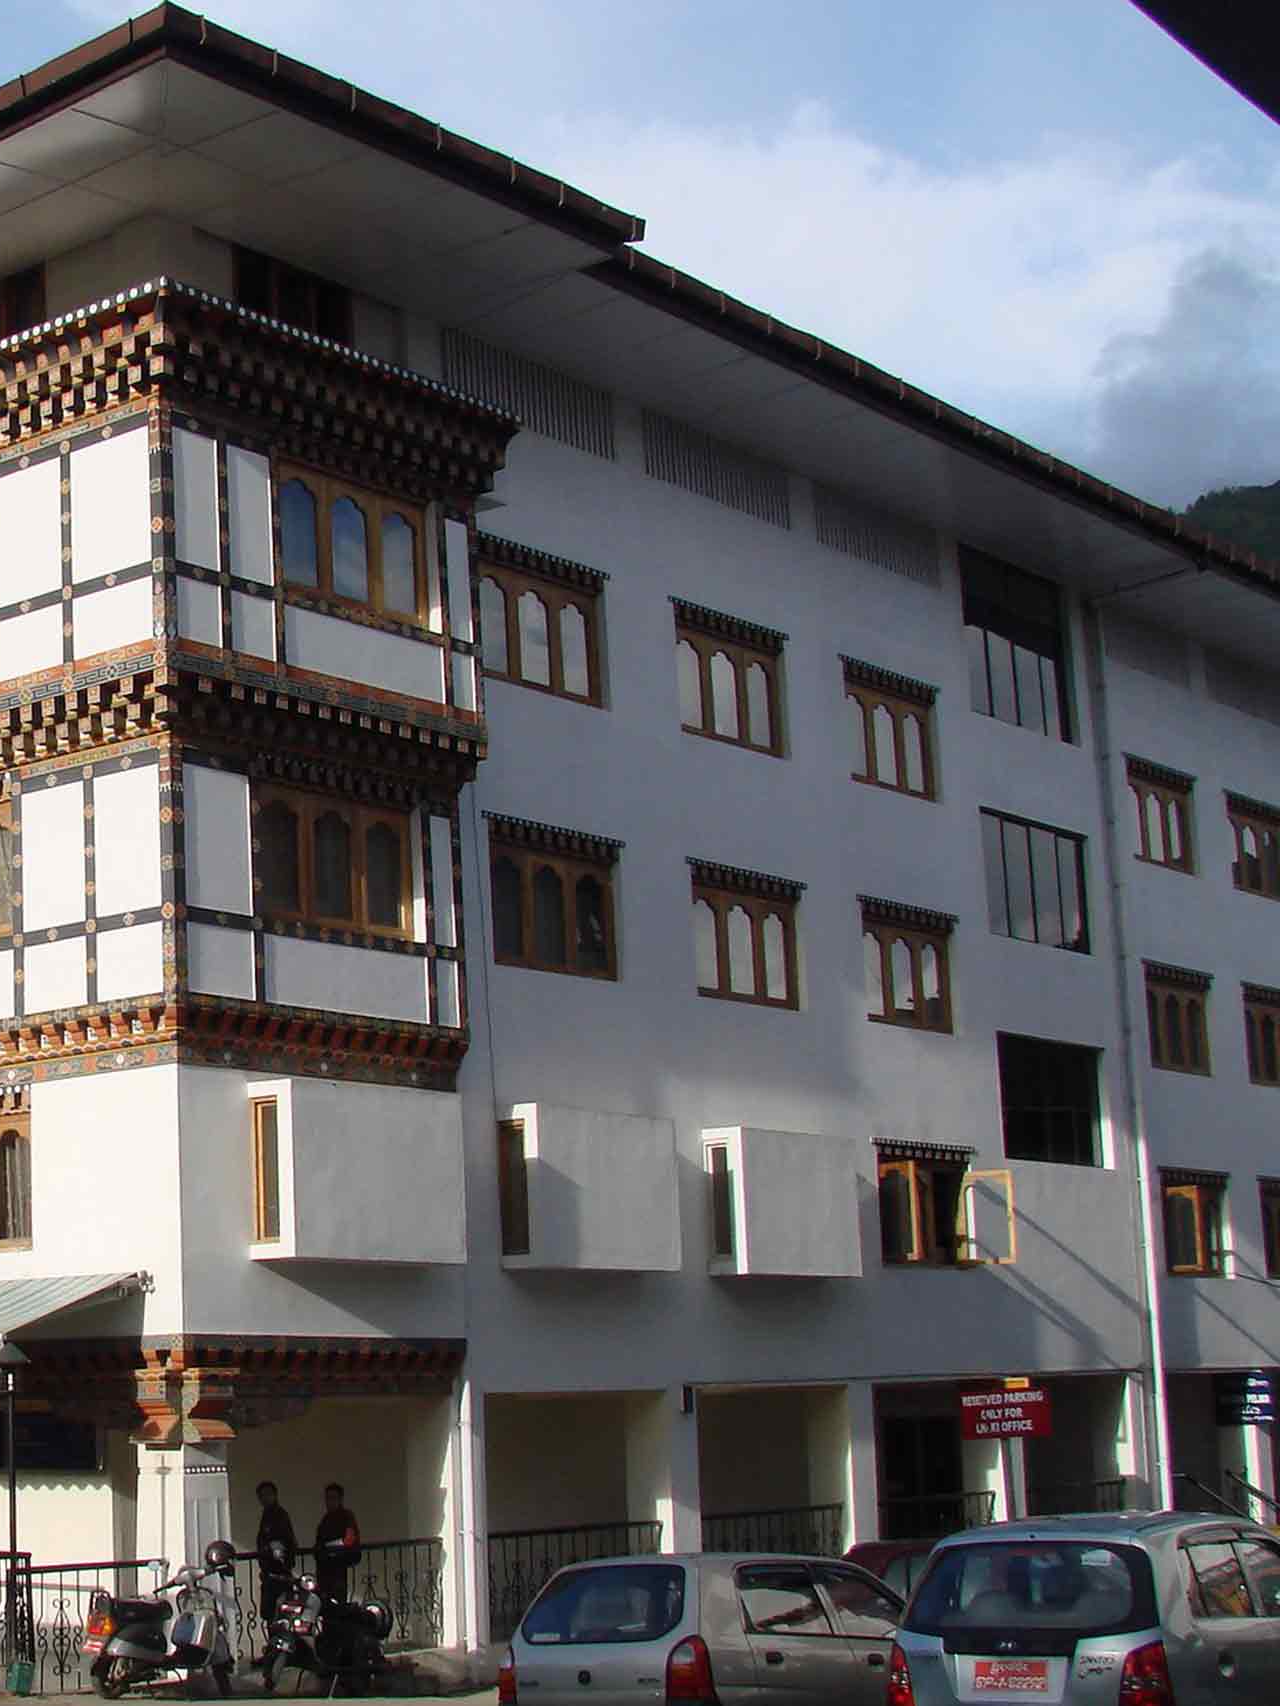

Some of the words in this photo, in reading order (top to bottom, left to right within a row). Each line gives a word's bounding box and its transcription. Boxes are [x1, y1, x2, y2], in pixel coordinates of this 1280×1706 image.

[961, 1394, 1003, 1407] RESERVED
[1004, 1391, 1044, 1403] PARKING
[980, 1409, 1003, 1420] ONLY
[1004, 1407, 1024, 1418] FOR
[1001, 1420, 1034, 1432] OFFICE
